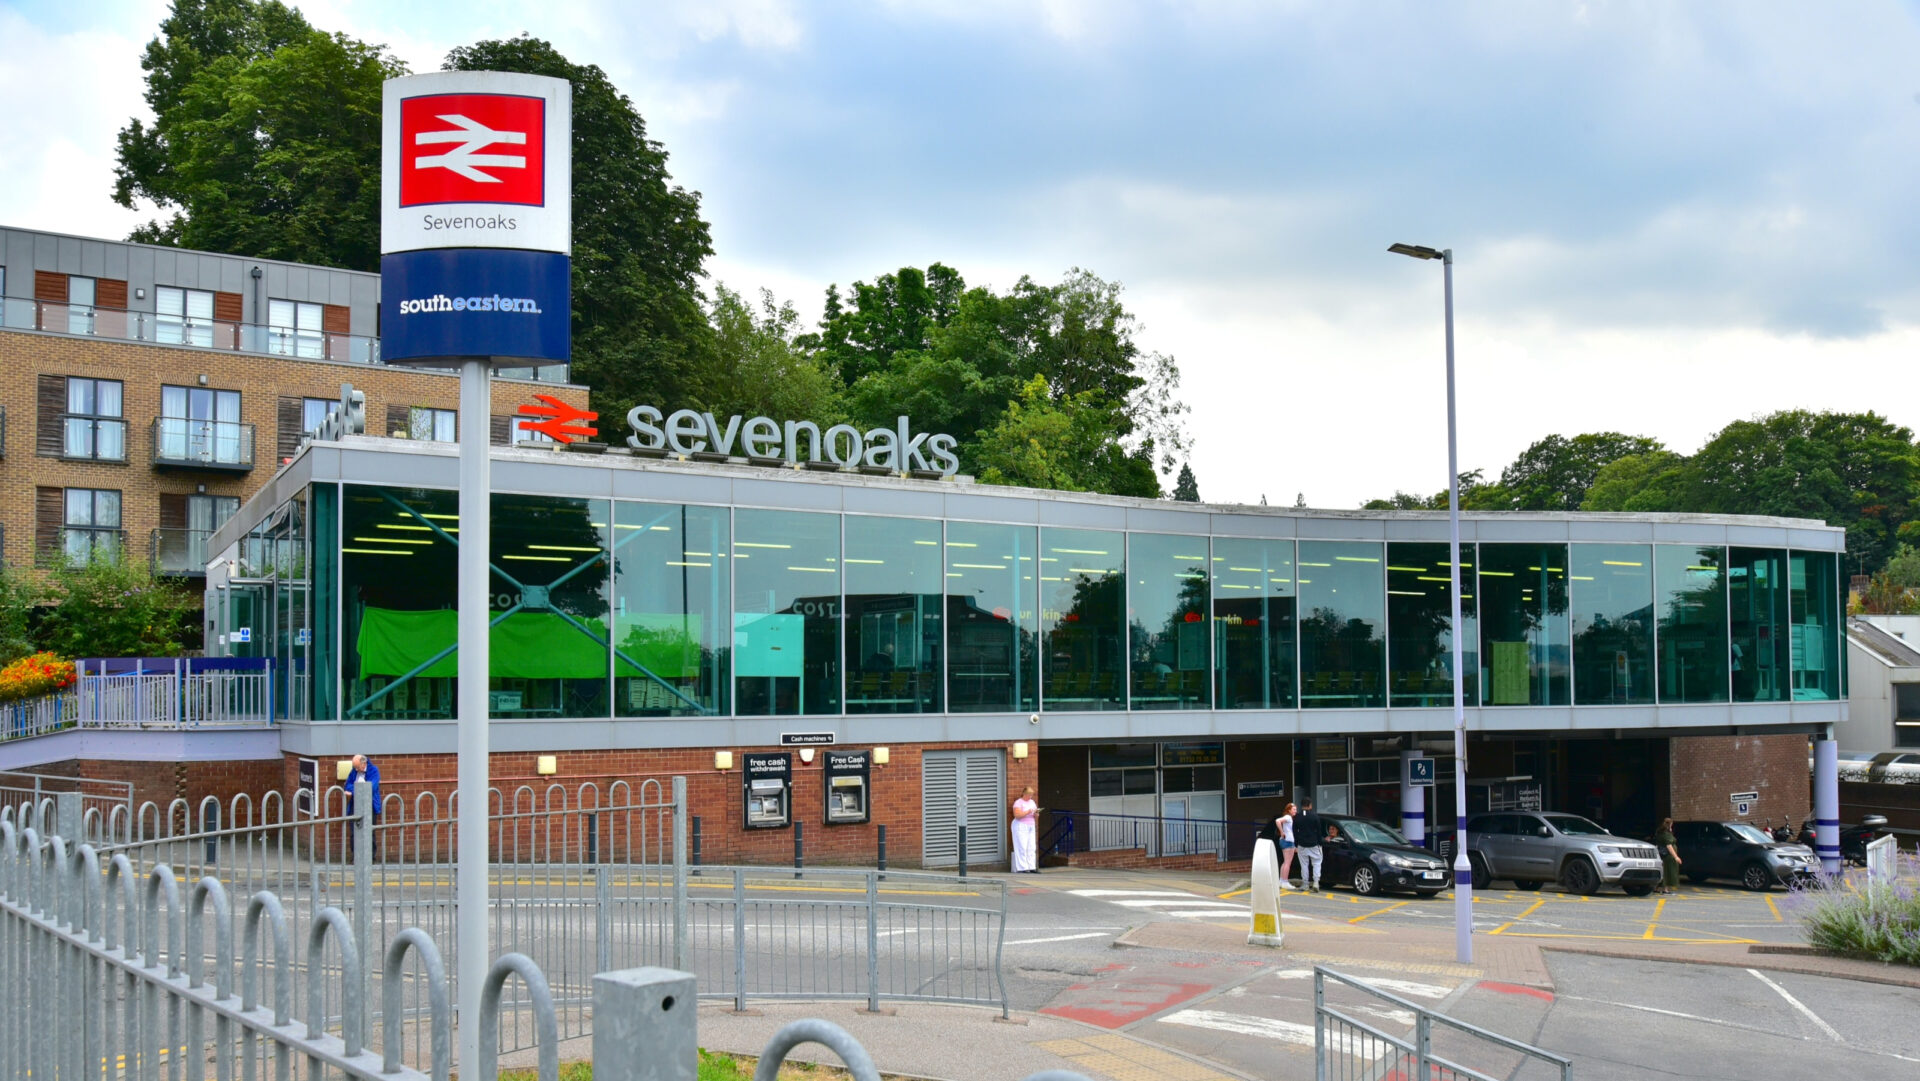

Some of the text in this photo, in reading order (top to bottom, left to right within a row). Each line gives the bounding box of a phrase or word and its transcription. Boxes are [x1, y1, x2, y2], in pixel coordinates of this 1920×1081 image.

[423, 214, 517, 231] Sevenoaks
[626, 404, 960, 477] sevenoaks
[792, 602, 836, 617] COST
[750, 757, 786, 766] free cash
[831, 755, 865, 764] Free Cash
[750, 765, 786, 773] withdrawals
